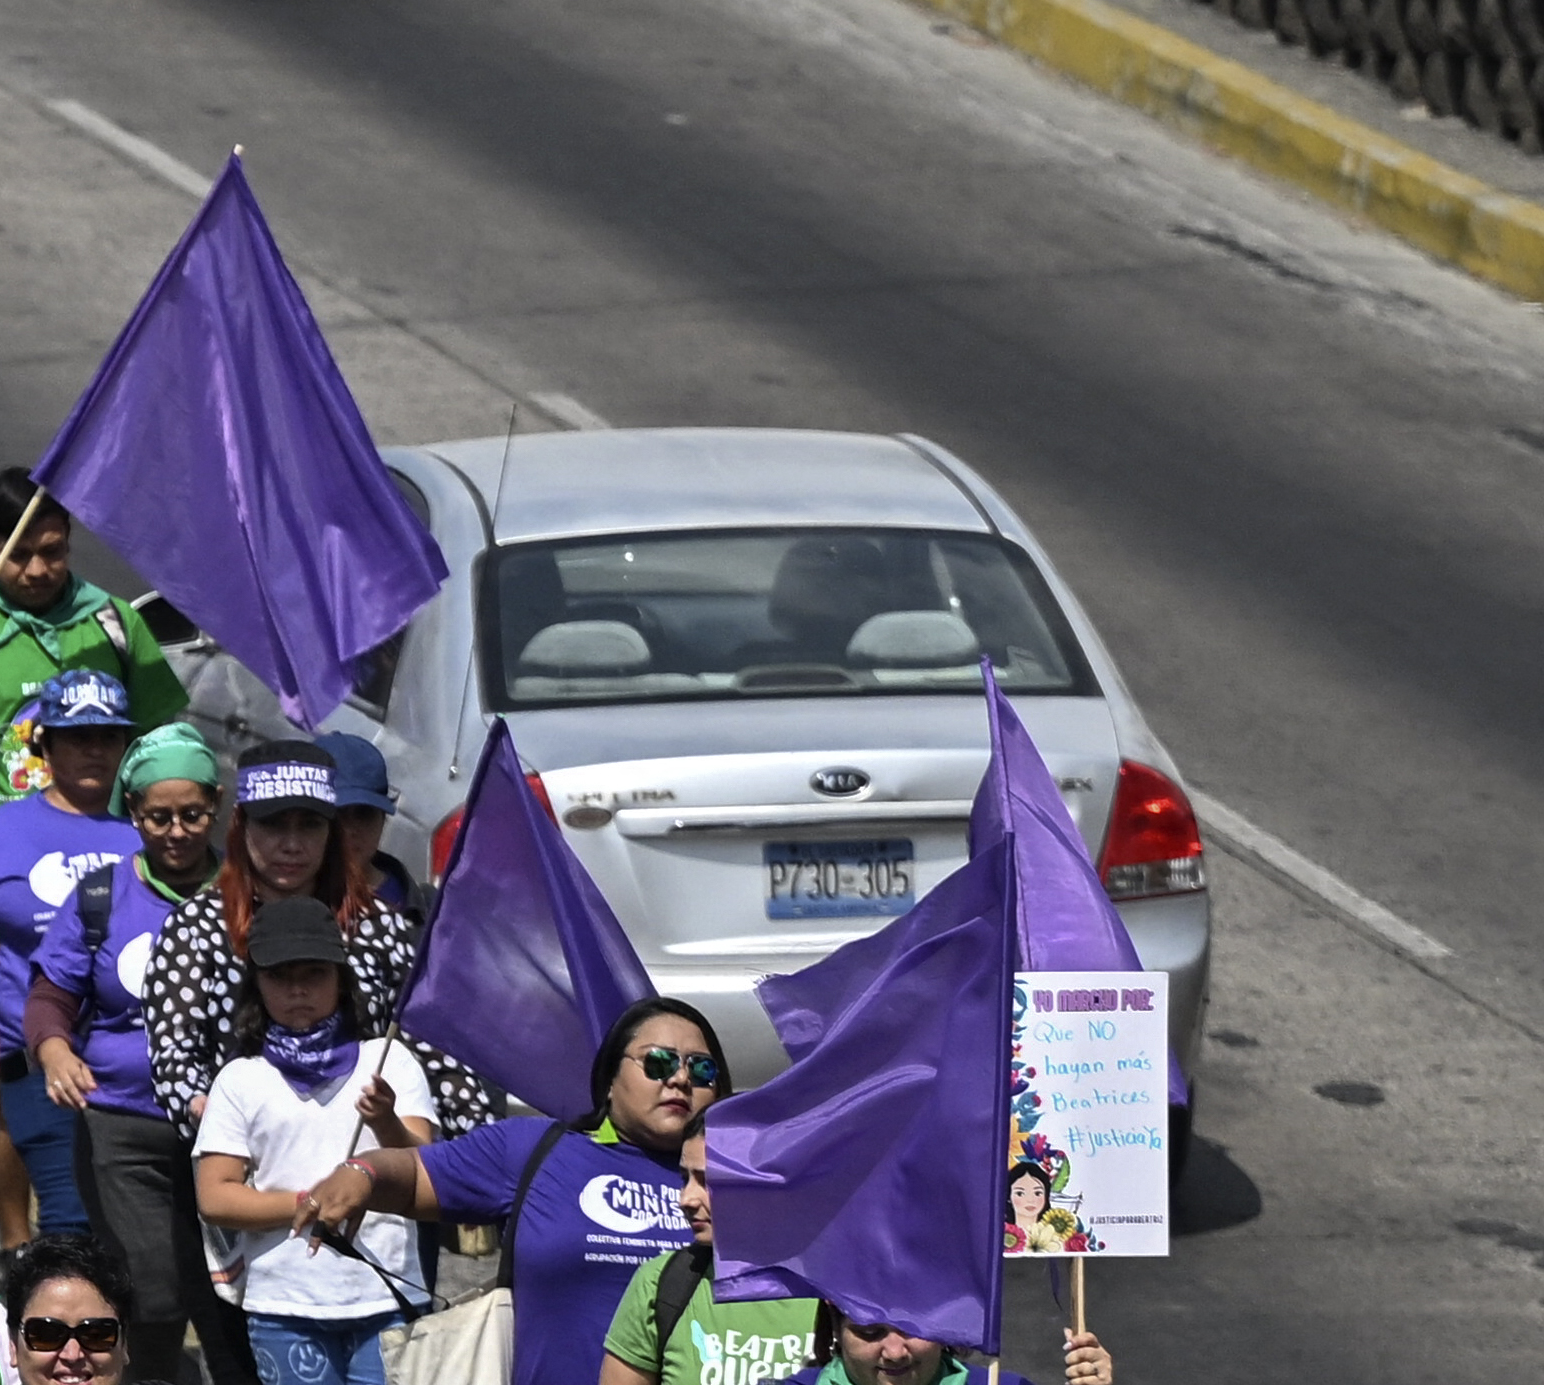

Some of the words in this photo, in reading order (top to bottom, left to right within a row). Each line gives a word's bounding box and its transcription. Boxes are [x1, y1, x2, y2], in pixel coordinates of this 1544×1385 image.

[272, 766, 328, 782] JUNTAS
[1033, 990, 1053, 1012] YO
[1057, 989, 1118, 1012] MARCHO
[1120, 989, 1154, 1012] POR:
[1033, 1021, 1073, 1043] Que
[1088, 1020, 1116, 1041] NO
[1044, 1054, 1105, 1083] hayan
[1117, 1050, 1152, 1071] más
[1051, 1089, 1151, 1113] Beatrices
